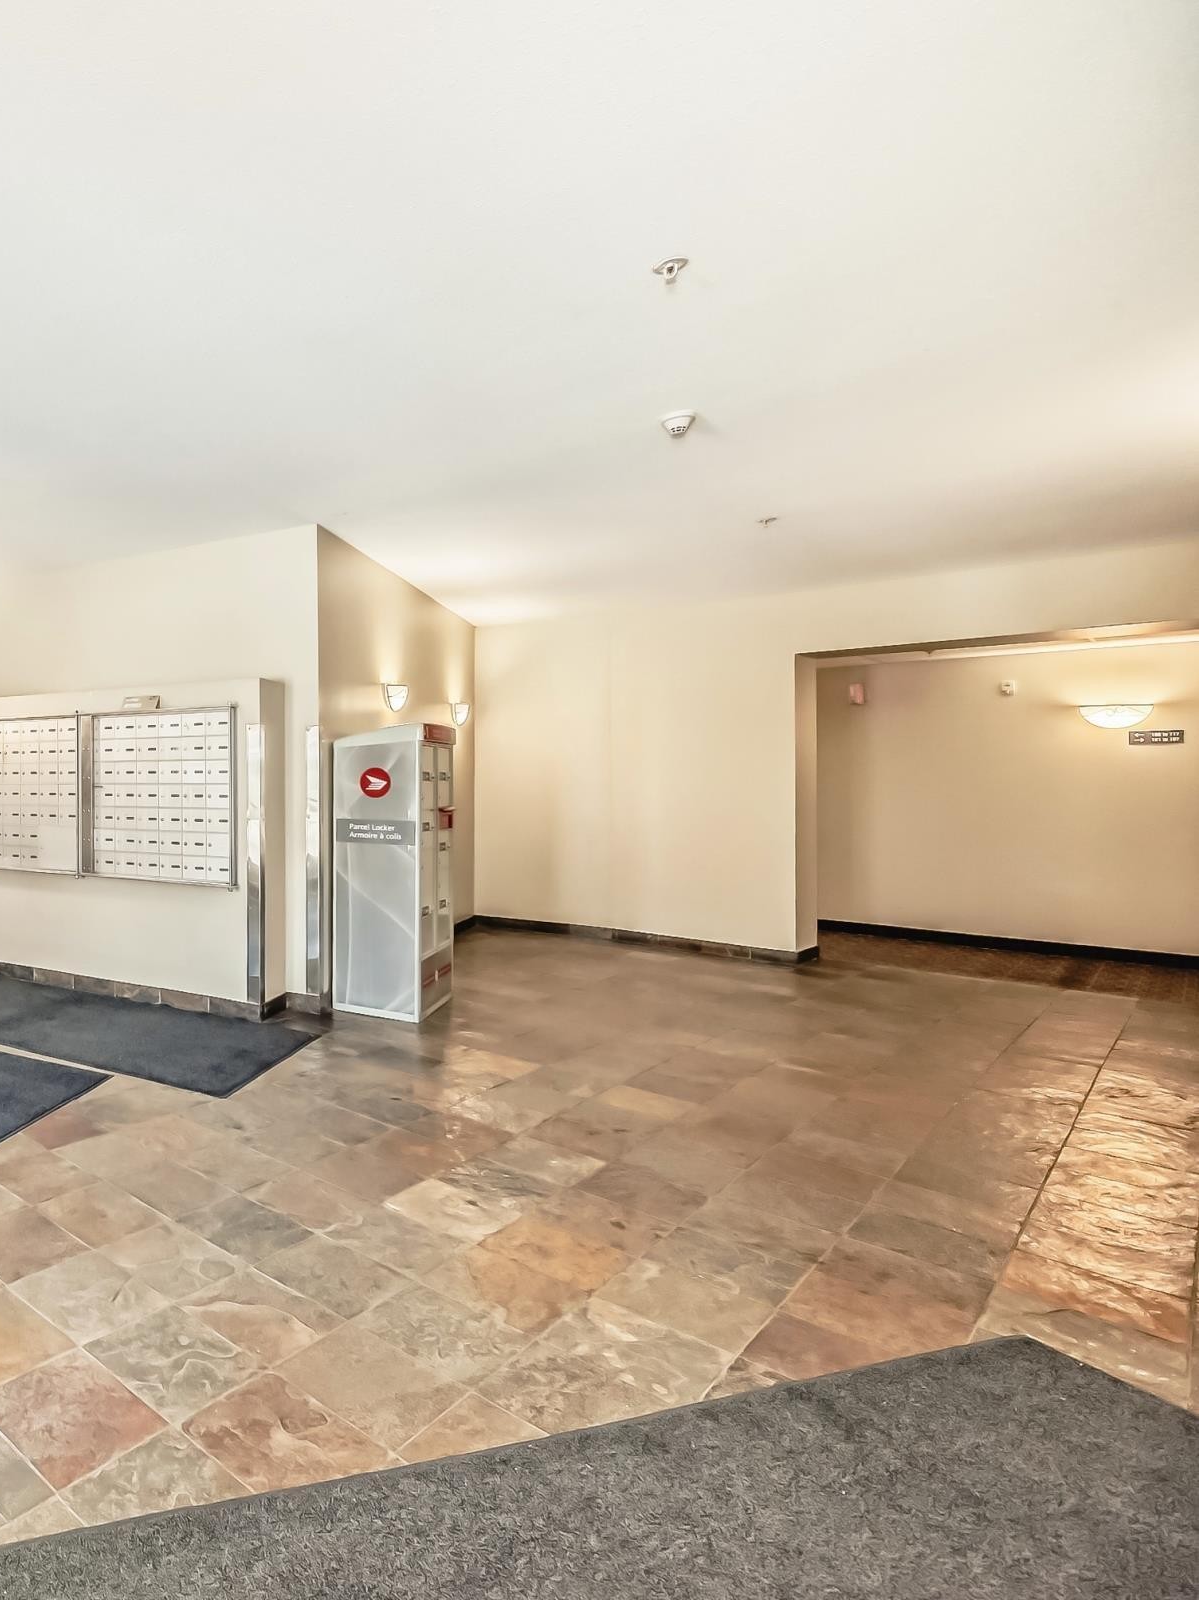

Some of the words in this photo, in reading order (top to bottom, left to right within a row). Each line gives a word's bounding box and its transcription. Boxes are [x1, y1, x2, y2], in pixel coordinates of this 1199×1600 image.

[349, 823, 370, 831] Parcel
[349, 831, 378, 839] Armoire
[385, 832, 402, 840] colis
